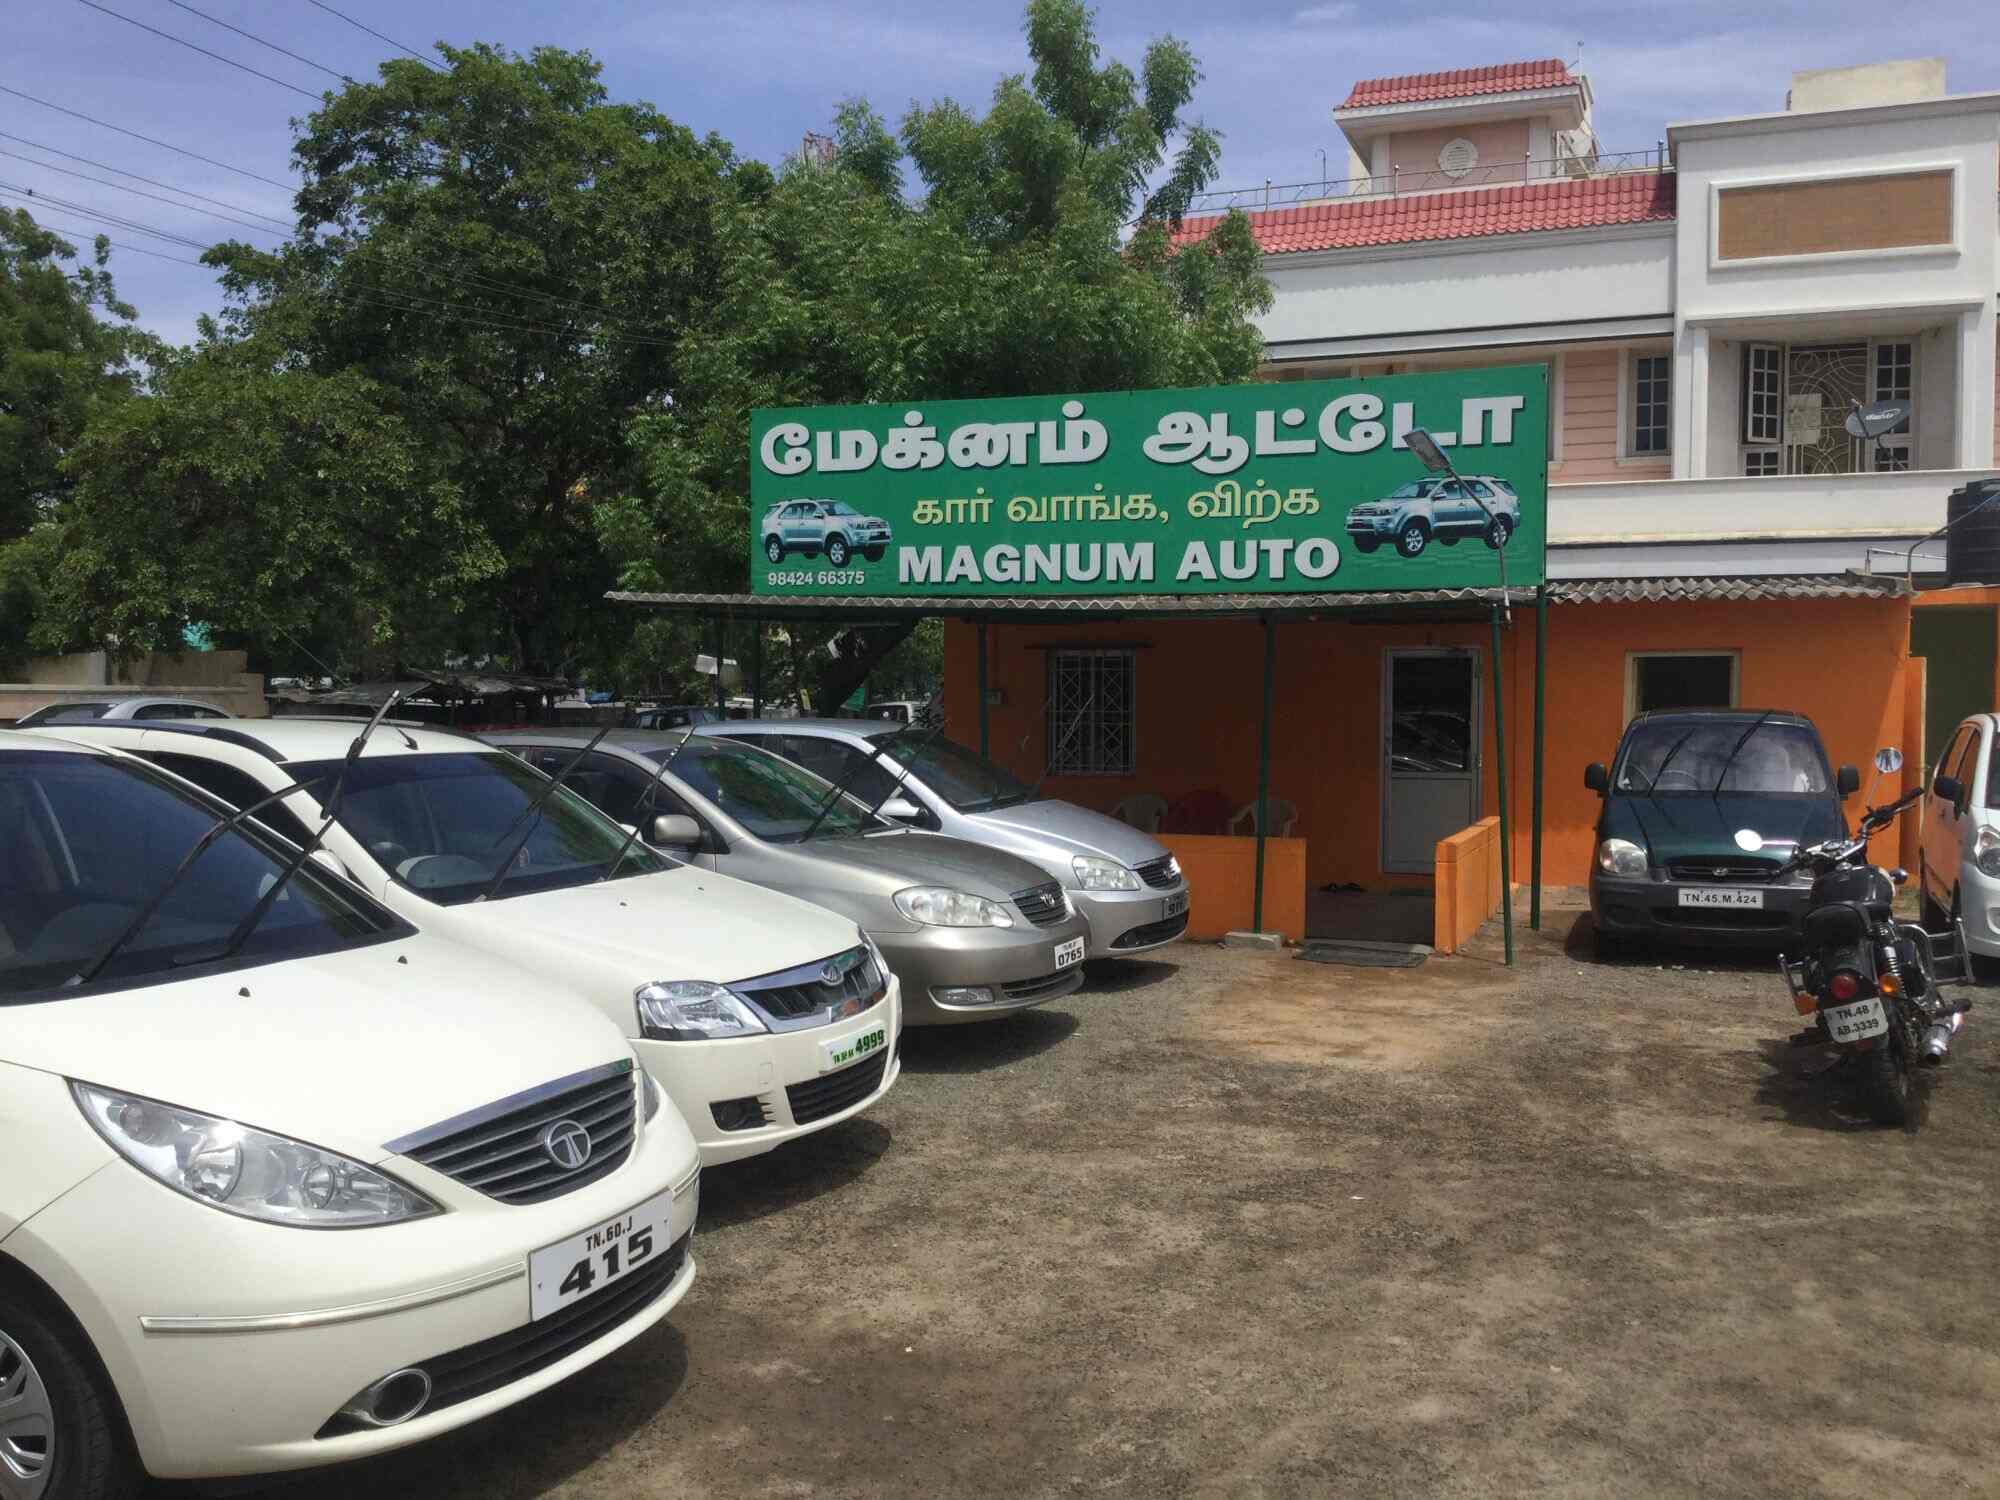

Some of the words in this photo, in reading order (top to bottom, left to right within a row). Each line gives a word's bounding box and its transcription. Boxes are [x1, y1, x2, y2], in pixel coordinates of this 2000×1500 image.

[760, 400, 1109, 475] மேக்னம்
[1143, 393, 1524, 475] ஆட்டோ
[912, 487, 994, 524] கார்
[1007, 482, 1169, 524] வாங்க,
[1187, 479, 1320, 529] விற்க
[768, 572, 813, 586] 98424
[817, 570, 865, 585] 66375
[899, 542, 1155, 584] MAGNUM
[1175, 537, 1340, 581] AUTO
[1058, 946, 1082, 966] 0765
[559, 1225, 653, 1297] 415
